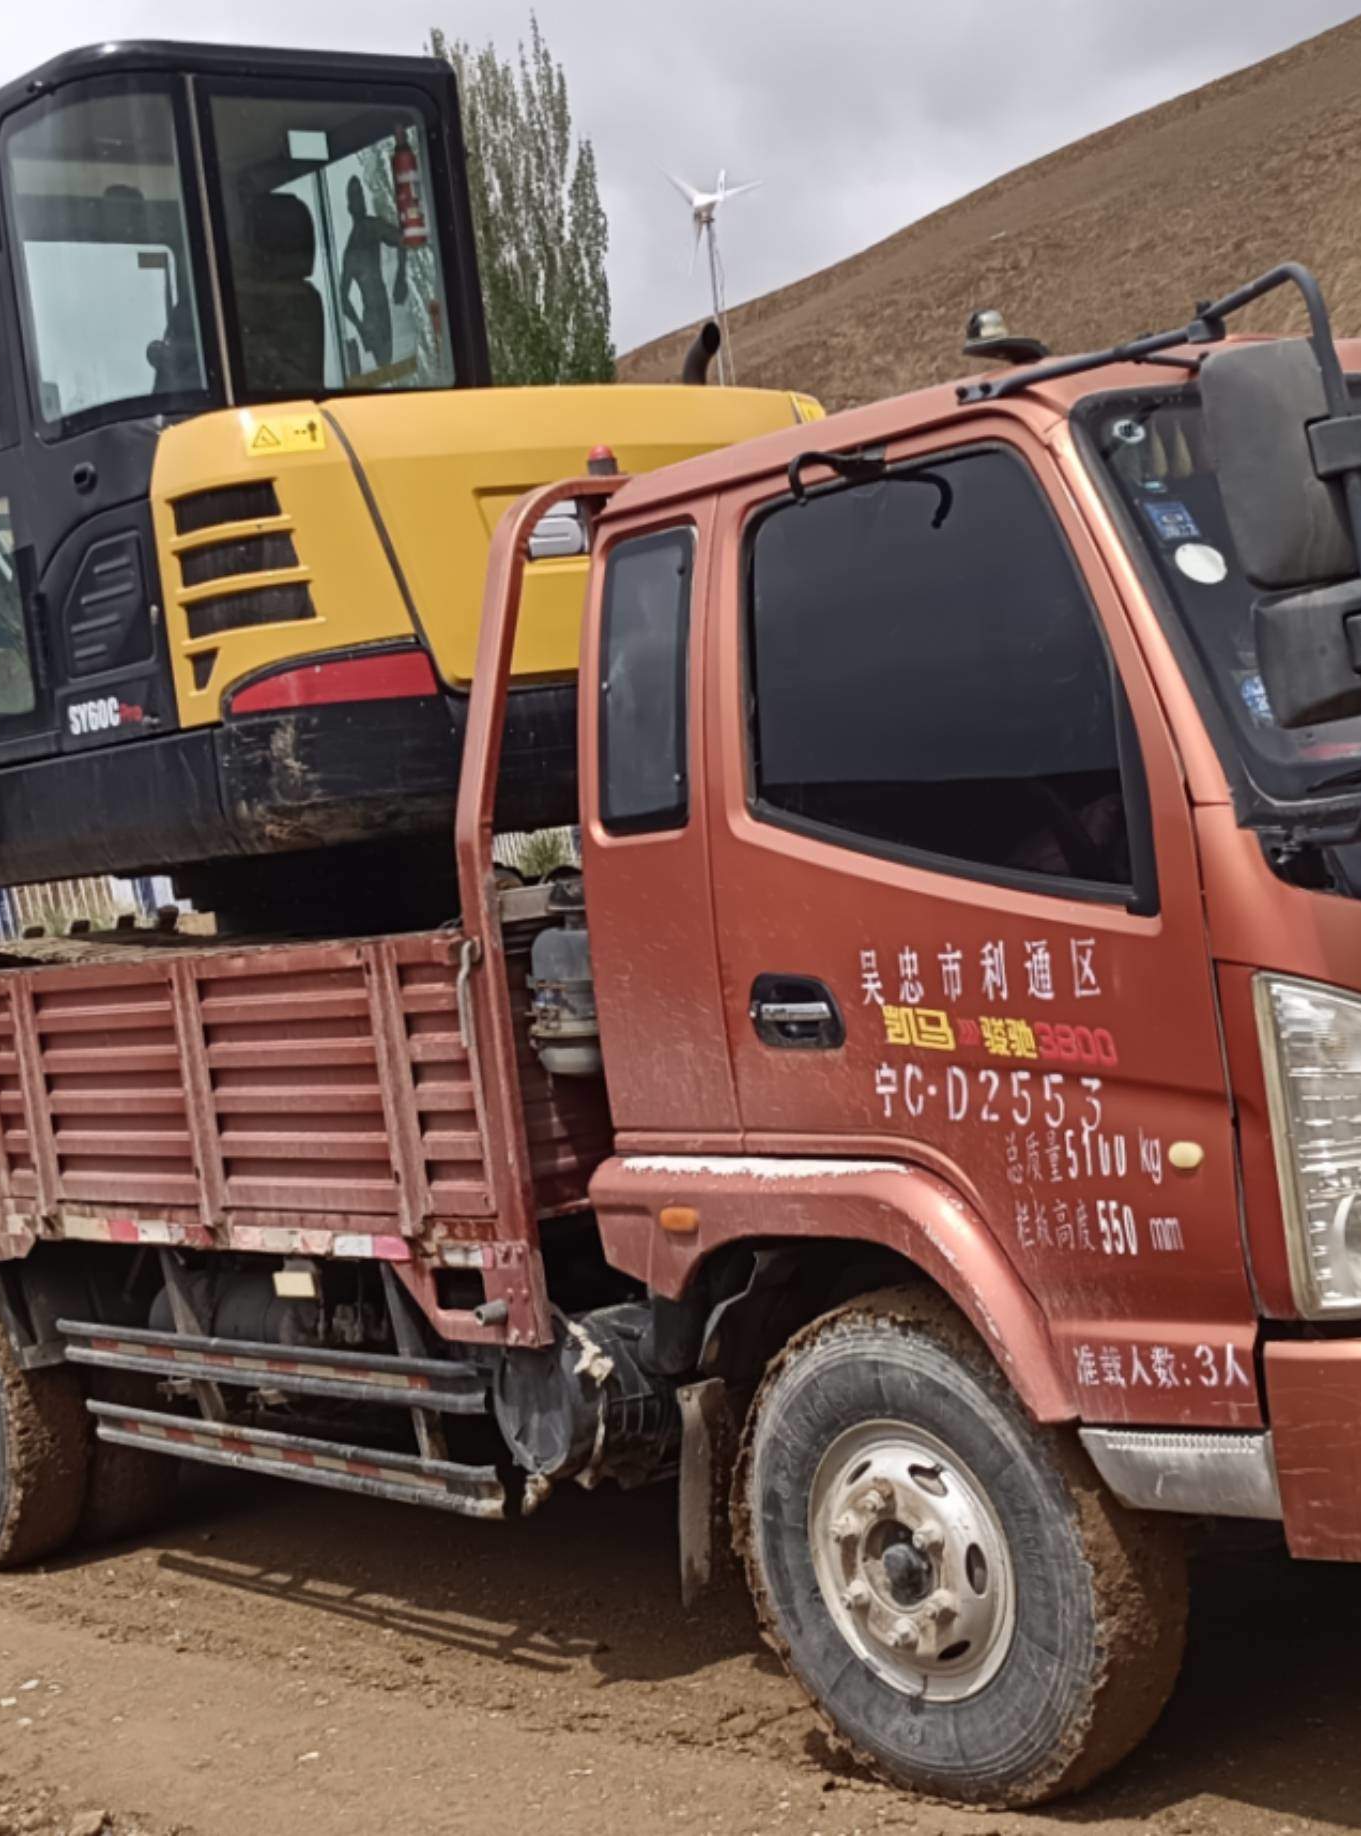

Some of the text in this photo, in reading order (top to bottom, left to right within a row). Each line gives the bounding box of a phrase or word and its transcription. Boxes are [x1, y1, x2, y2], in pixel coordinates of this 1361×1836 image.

[68, 696, 121, 735] SY60C
[860, 939, 1102, 1006] 吴忠市利通区
[882, 1003, 956, 1051] 凯马
[1138, 1126, 1162, 1184] kg
[1149, 1217, 1185, 1250] mm
